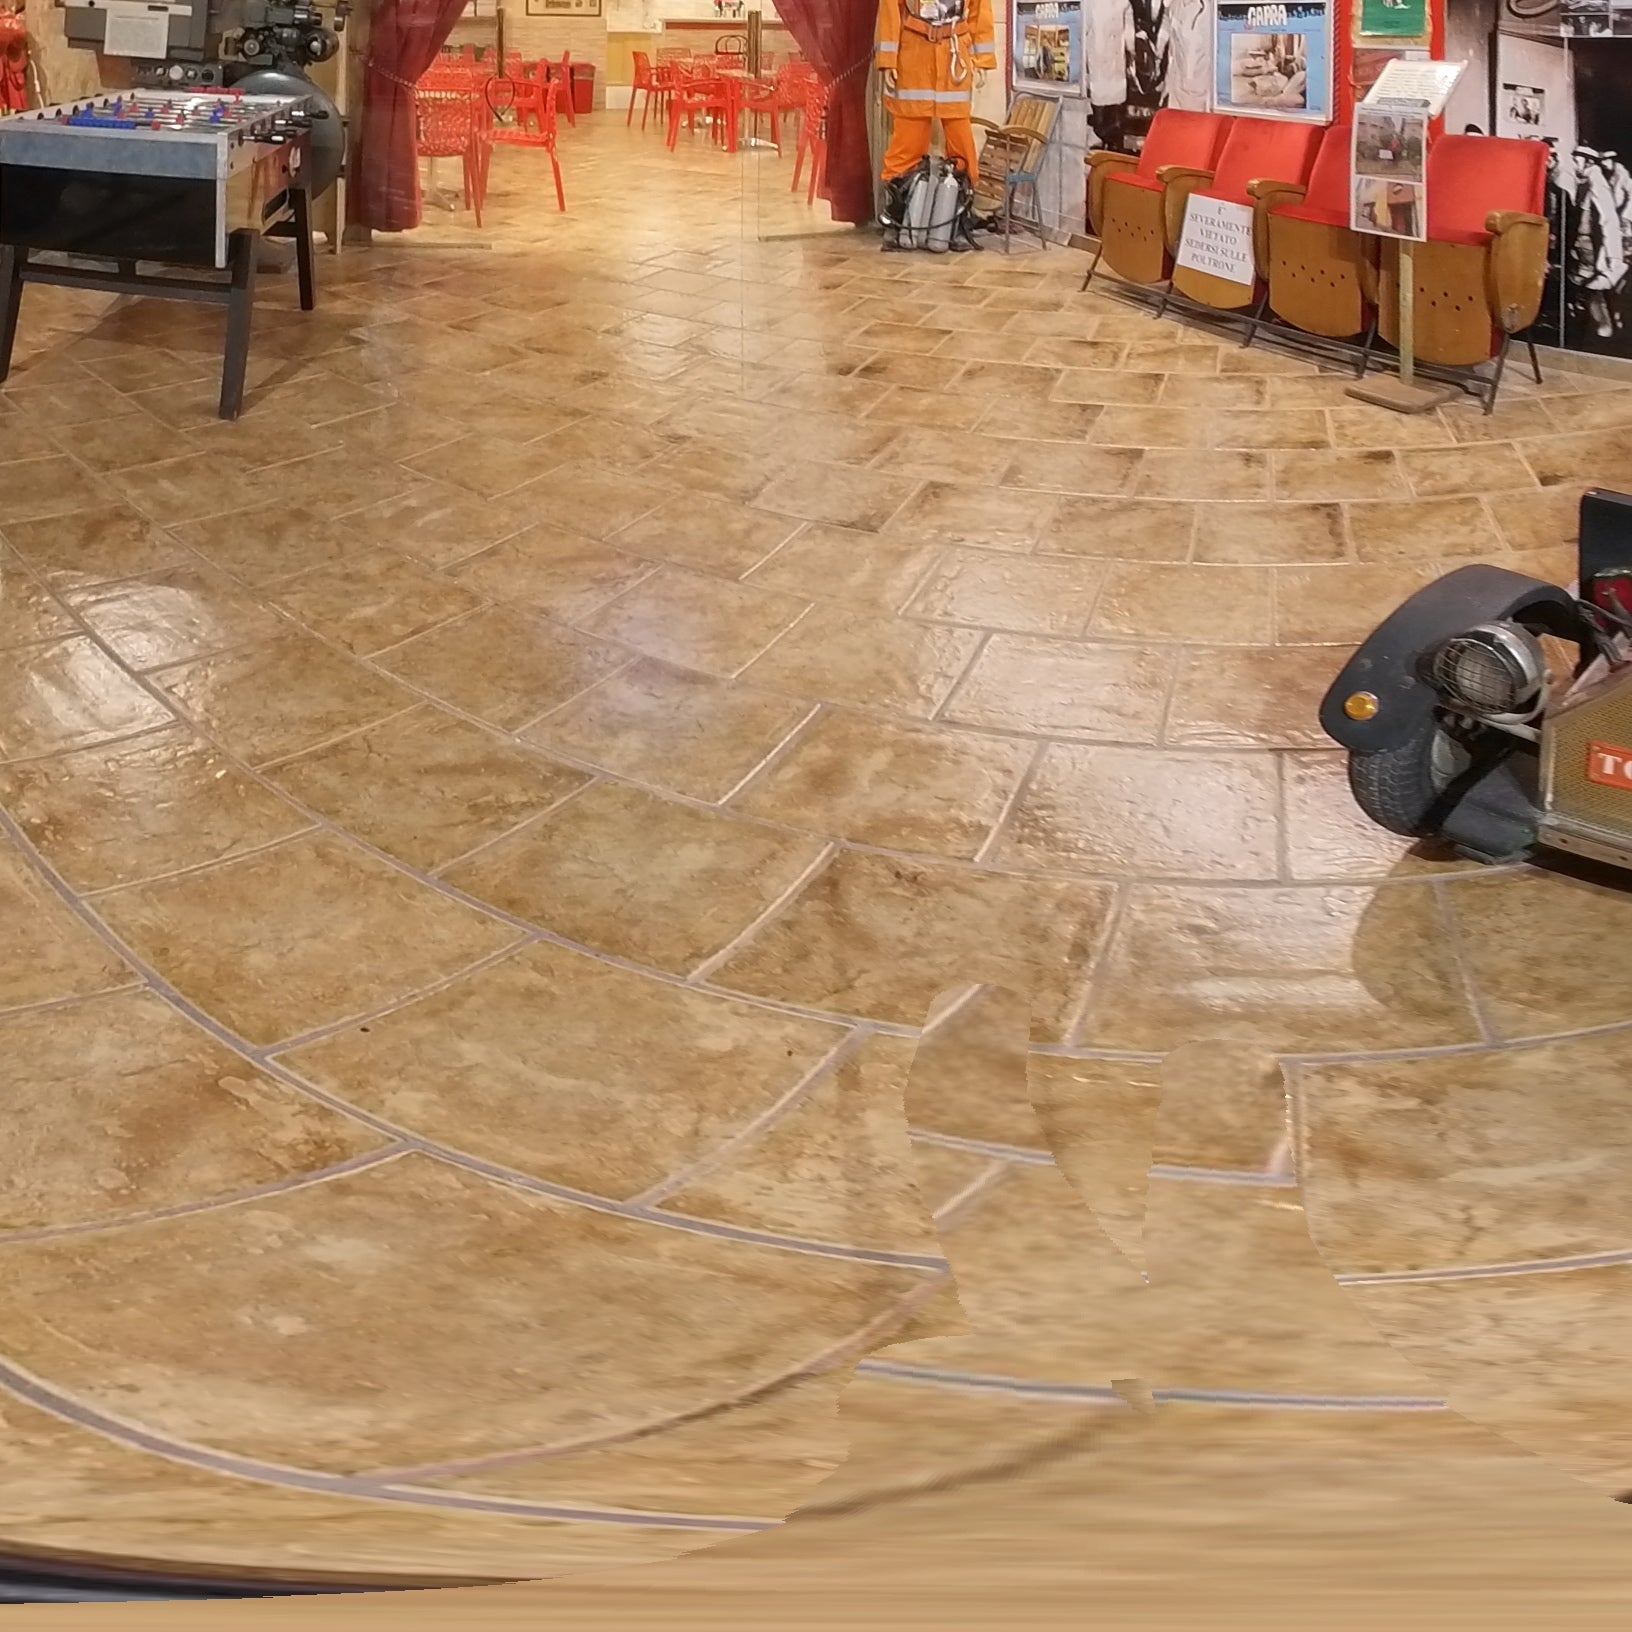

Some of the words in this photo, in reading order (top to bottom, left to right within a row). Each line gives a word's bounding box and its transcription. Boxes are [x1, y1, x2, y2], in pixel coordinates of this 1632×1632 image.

[1034, 2, 1060, 19] CAPRA
[1247, 4, 1288, 26] CAPRA
[1189, 213, 1253, 236] SEVERAMENTE
[1200, 228, 1237, 245] VIETATO
[1191, 253, 1236, 273] POLTRONE
[1220, 248, 1247, 263] SULLE
